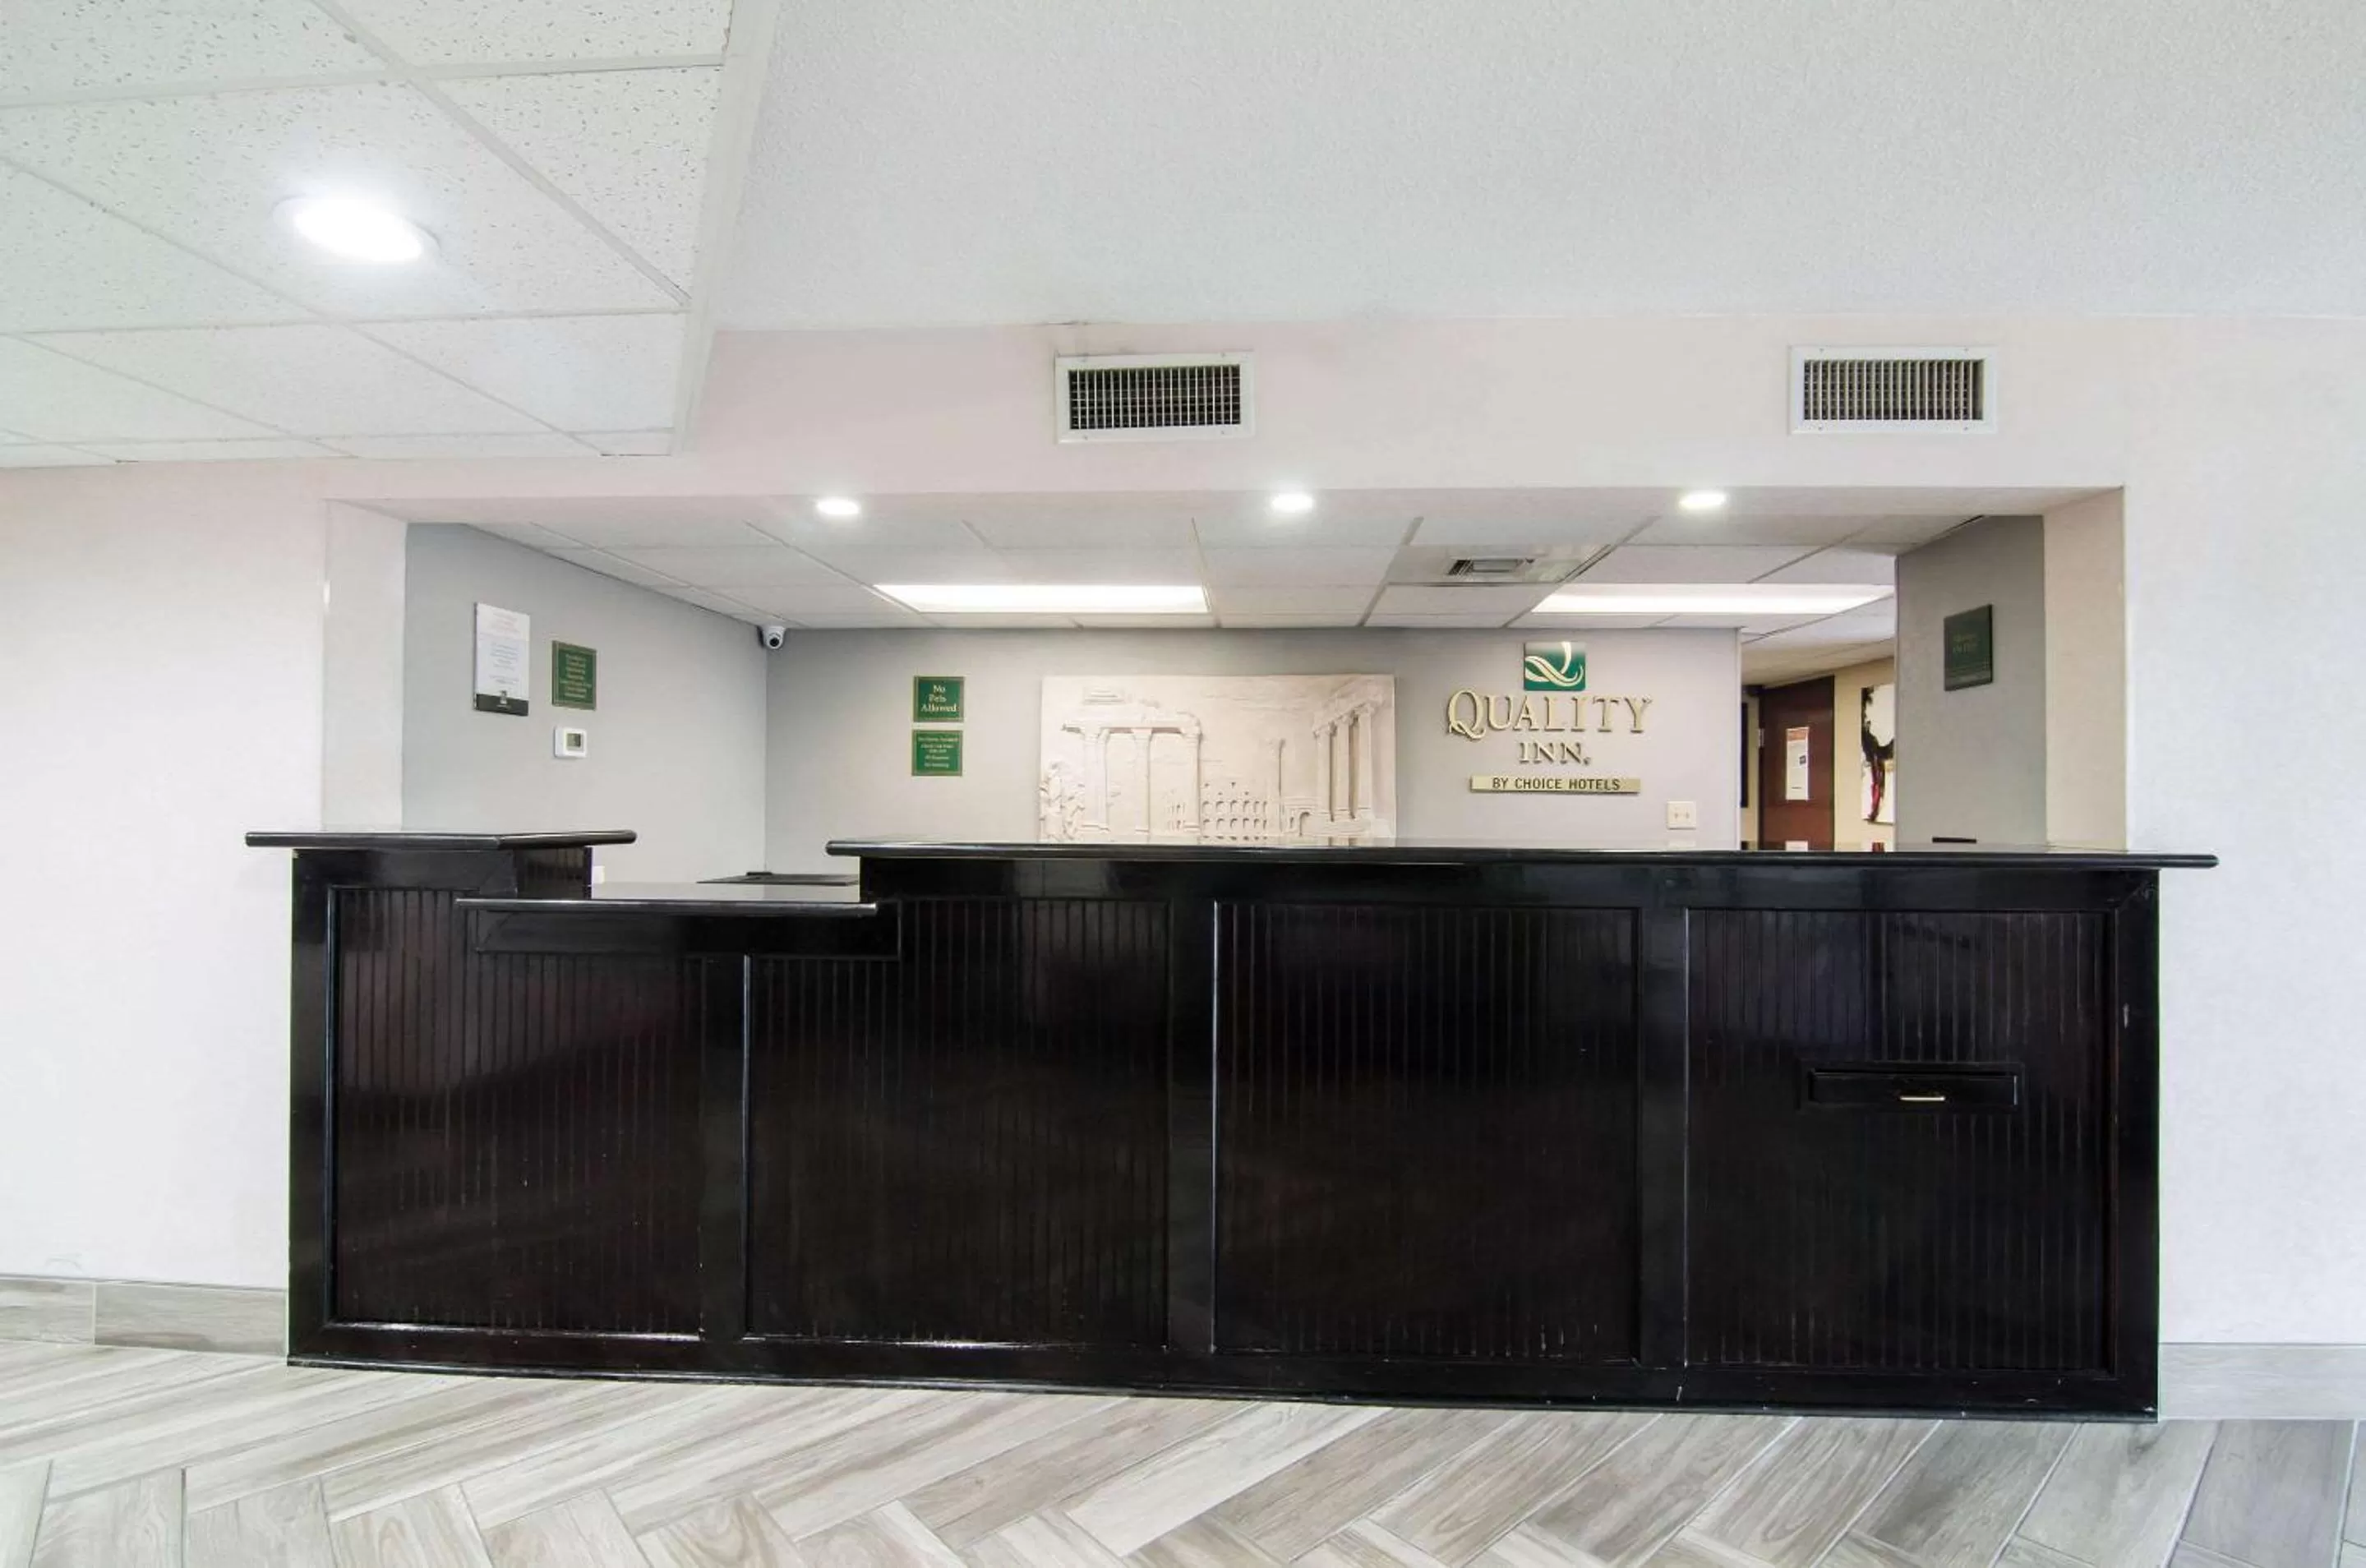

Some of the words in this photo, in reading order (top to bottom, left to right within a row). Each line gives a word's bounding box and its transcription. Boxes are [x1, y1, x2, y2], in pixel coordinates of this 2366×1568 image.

[933, 685, 946, 694] No
[1447, 689, 1652, 740] QUALITY
[1492, 777, 1509, 790] BY
[1515, 777, 1563, 790] CHOICE
[1568, 779, 1621, 791] HOTELS
